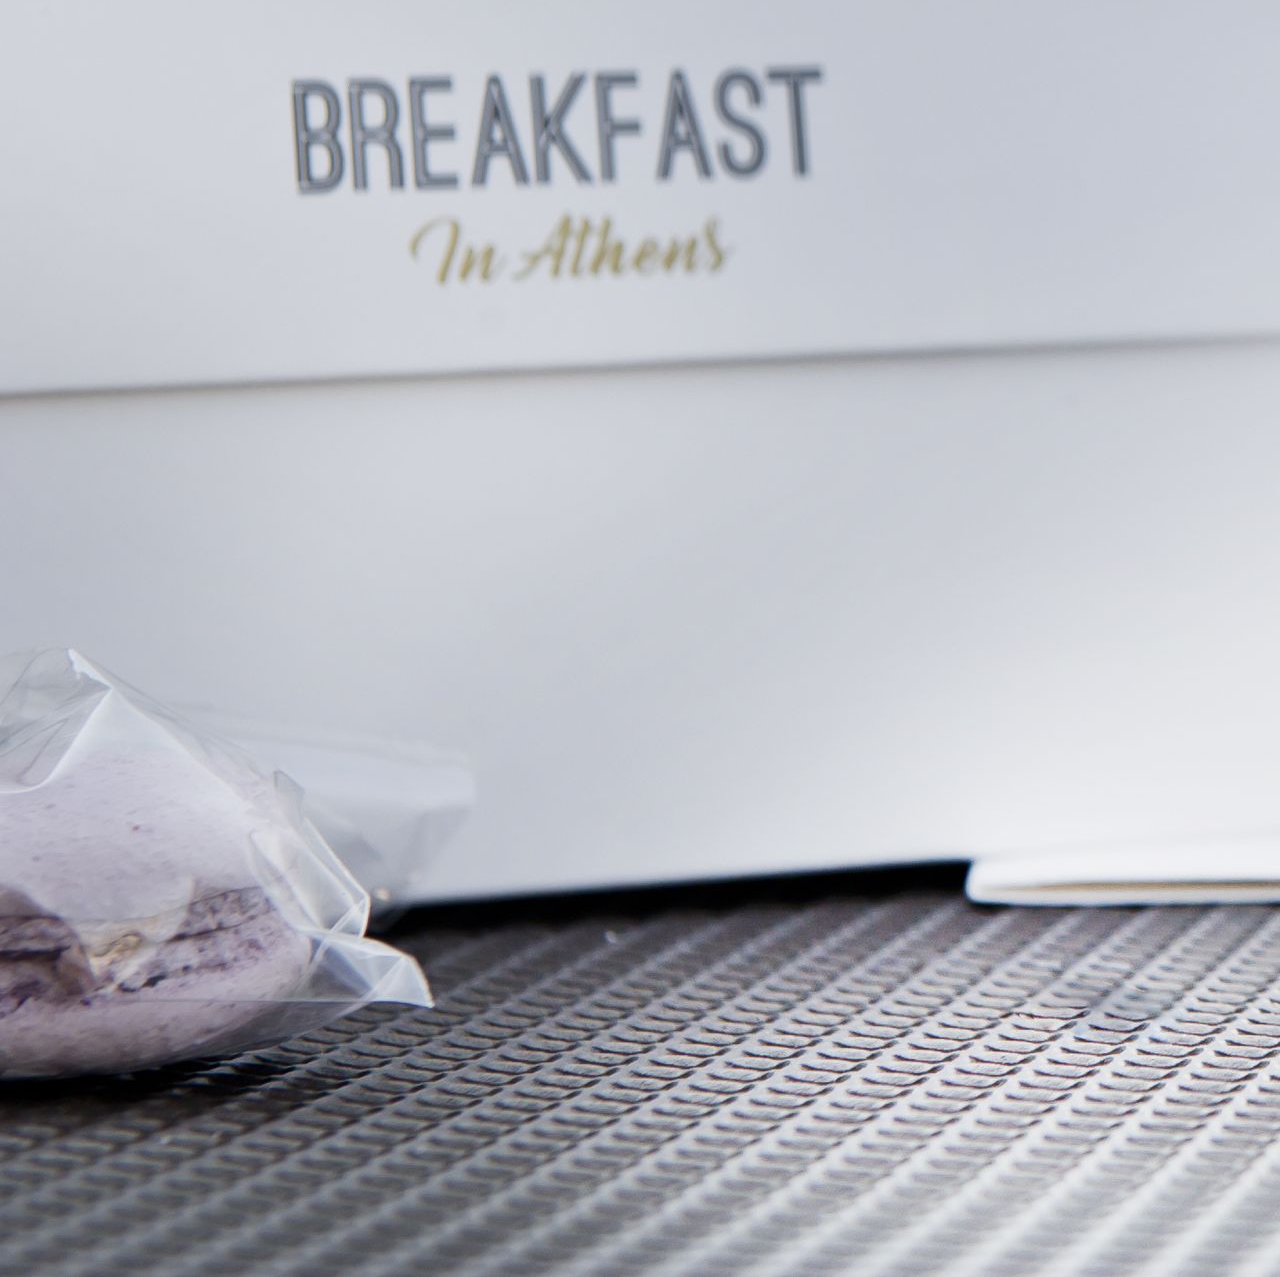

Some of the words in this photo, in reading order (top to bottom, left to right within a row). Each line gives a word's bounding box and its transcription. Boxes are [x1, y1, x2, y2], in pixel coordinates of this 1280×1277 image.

[290, 65, 824, 195] BREAKFAST
[409, 217, 505, 285] In
[512, 213, 737, 279] Athens
